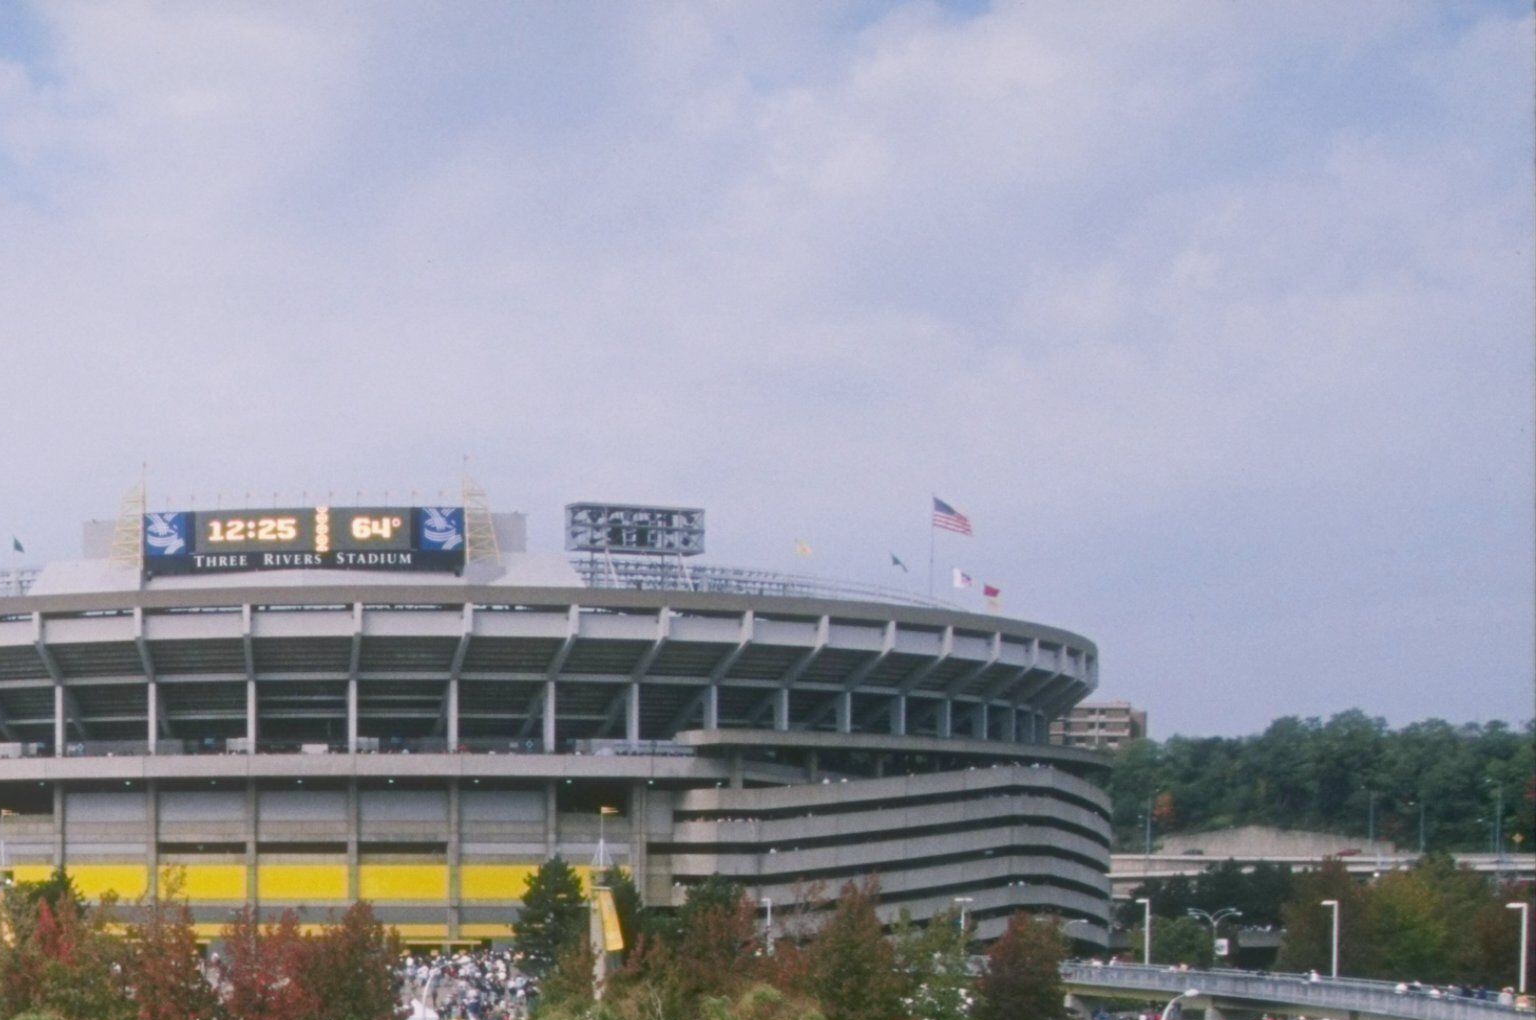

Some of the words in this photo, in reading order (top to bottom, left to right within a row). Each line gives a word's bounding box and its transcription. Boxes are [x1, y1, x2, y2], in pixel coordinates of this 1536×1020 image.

[208, 517, 296, 541] 12:25
[194, 554, 248, 568] THREE
[264, 552, 322, 566] RIVERS
[336, 551, 412, 565] STADIUM
